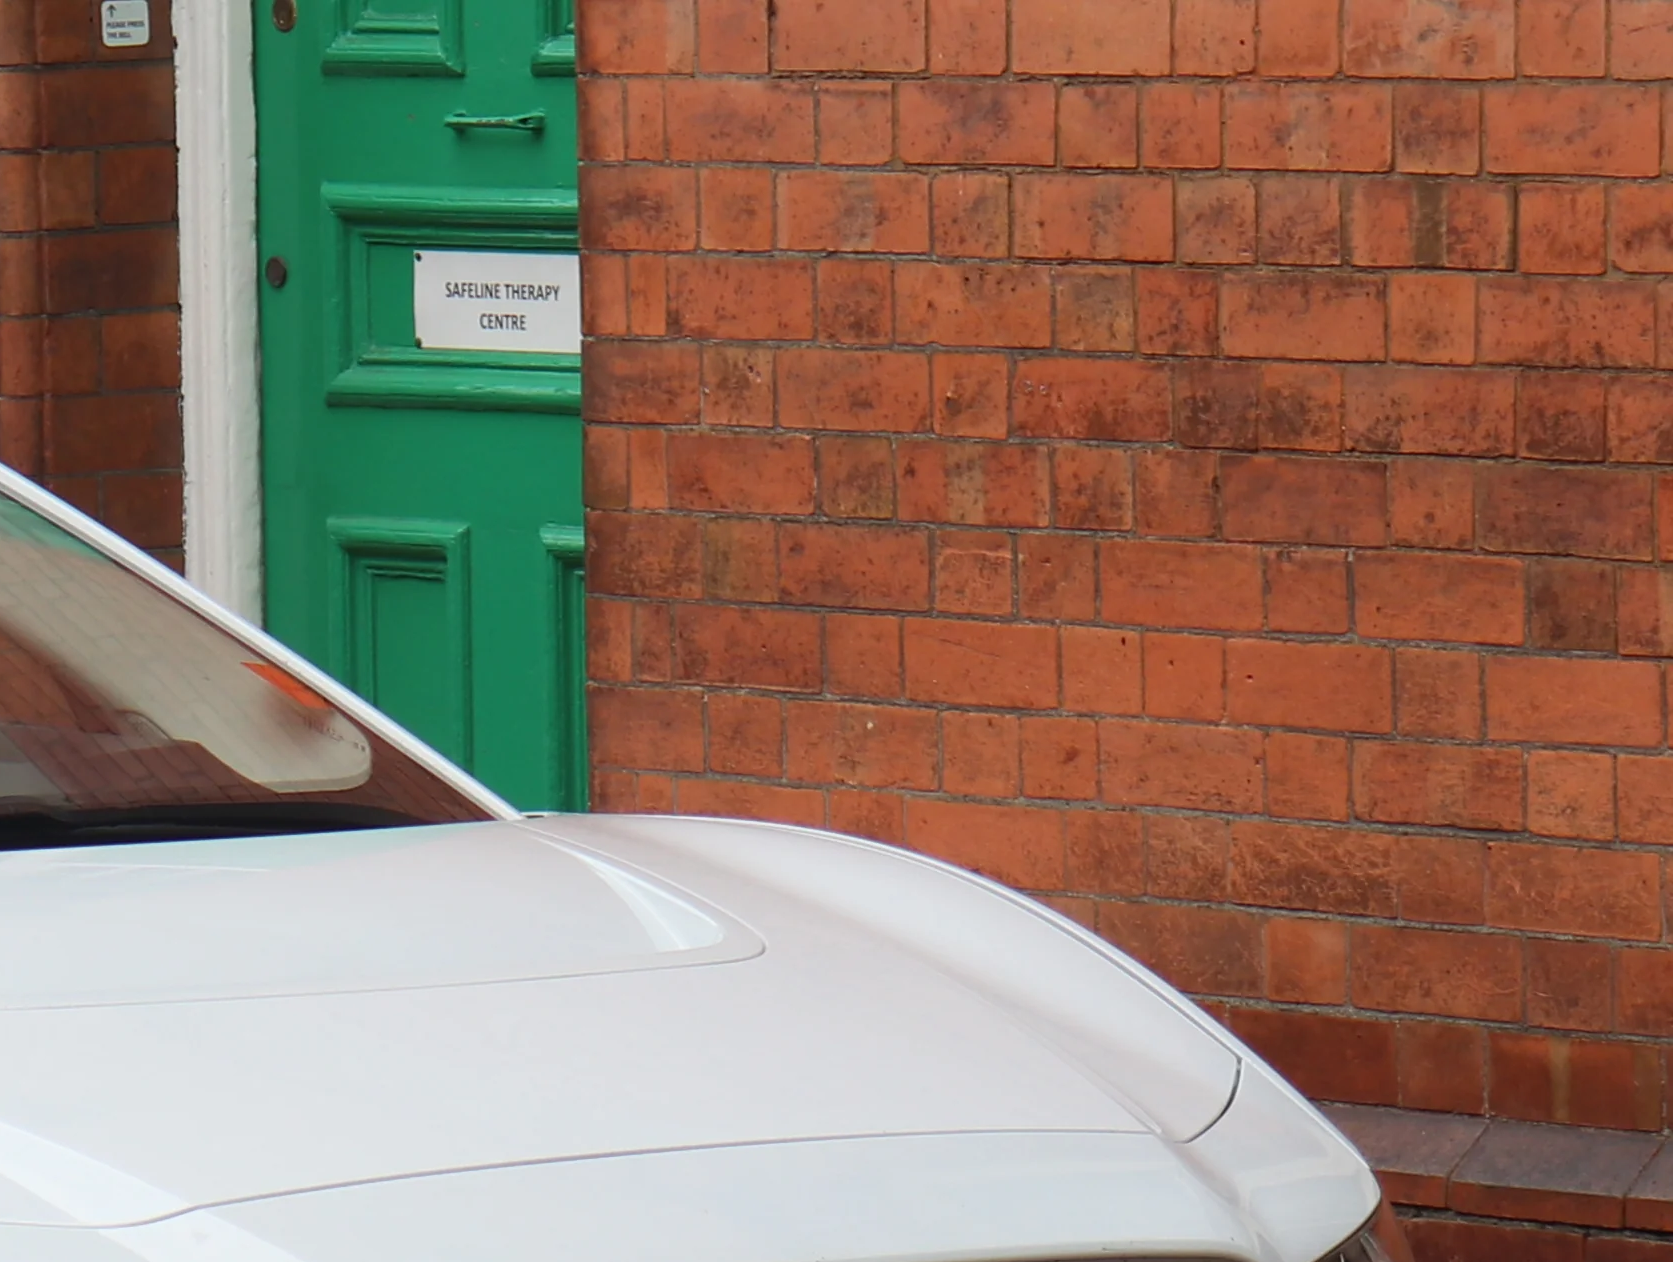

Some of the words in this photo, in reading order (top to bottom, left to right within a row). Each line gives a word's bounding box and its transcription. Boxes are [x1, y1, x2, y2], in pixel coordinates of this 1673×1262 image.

[445, 282, 501, 300] SAFELINE
[503, 283, 560, 301] THERAPY
[479, 313, 527, 331] CENTRE
